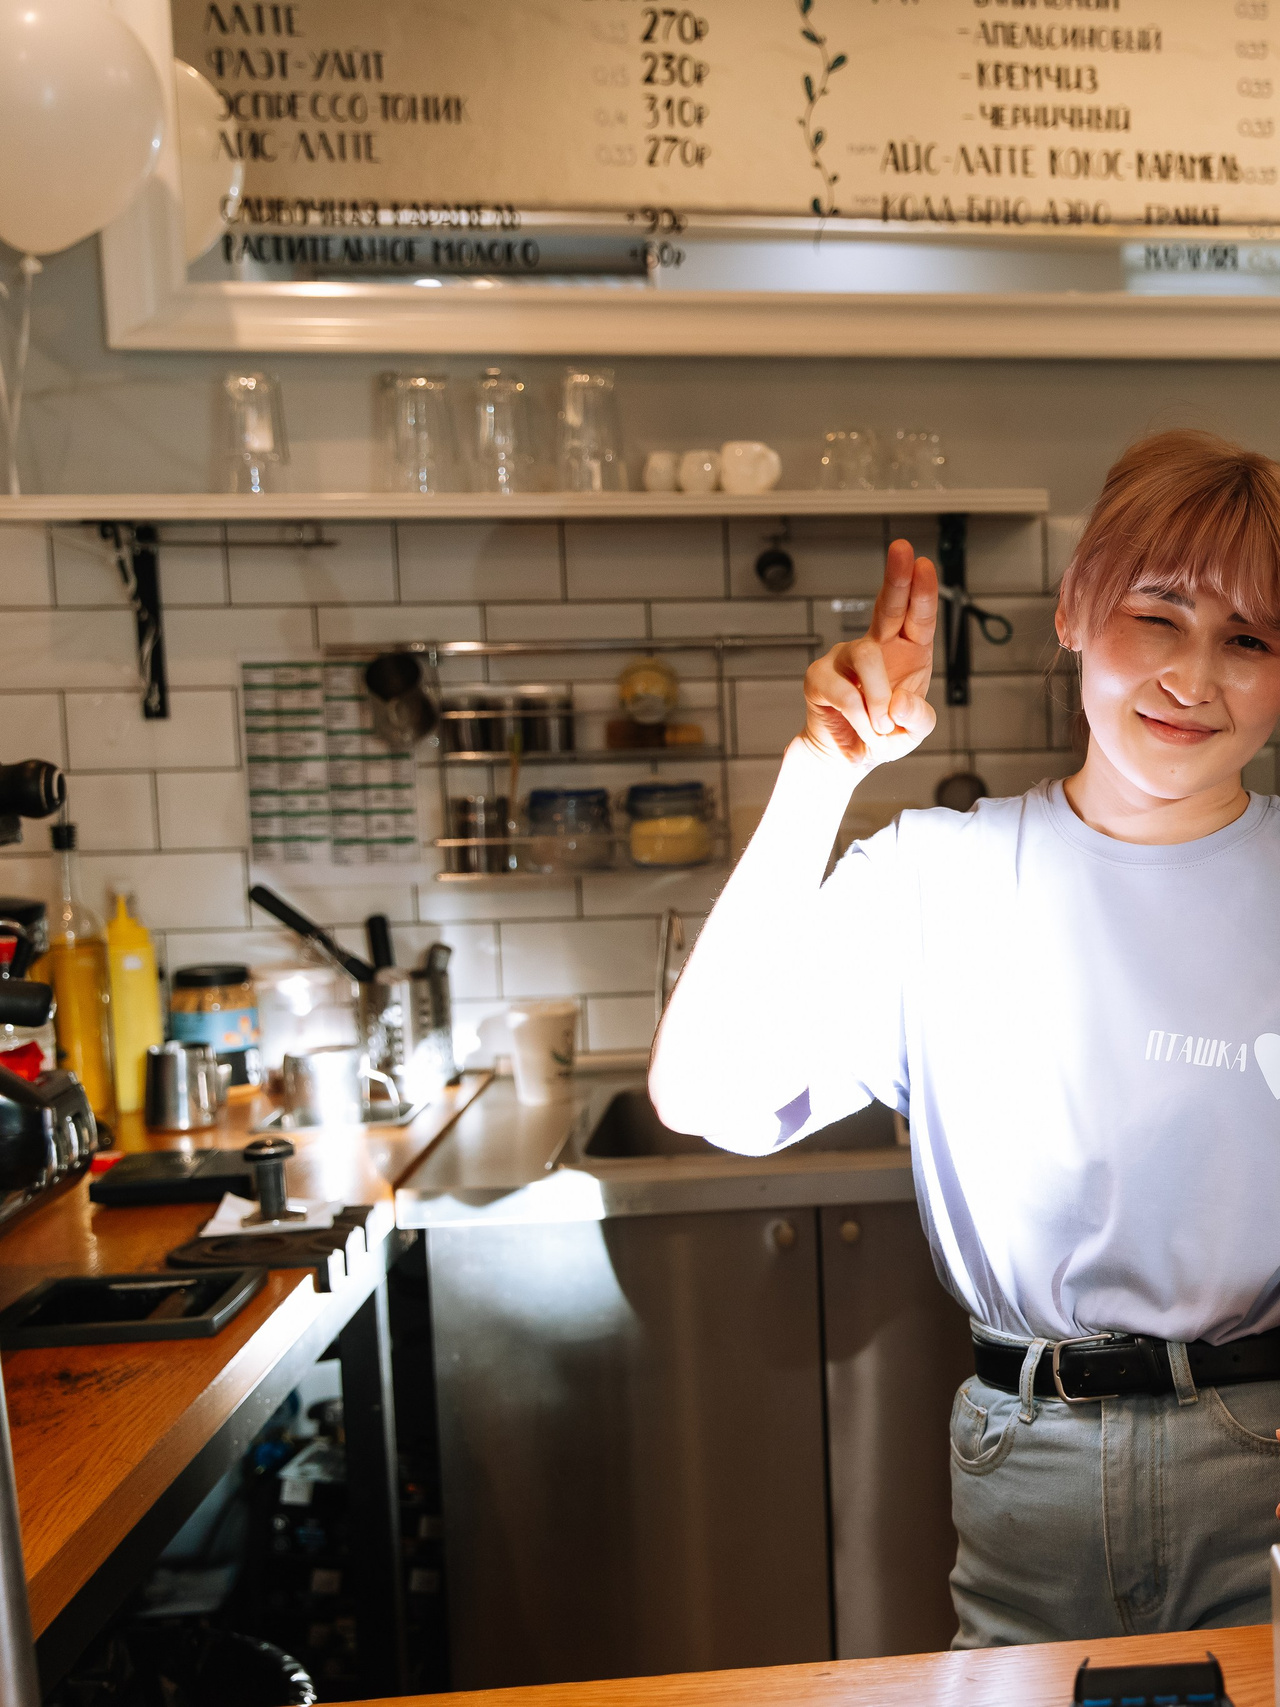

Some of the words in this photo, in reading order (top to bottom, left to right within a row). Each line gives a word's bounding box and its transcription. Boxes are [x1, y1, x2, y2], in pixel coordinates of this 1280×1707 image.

[203, 2, 302, 37] ЛАТТЕ
[974, 20, 1162, 53] АПЕЛЬСИНОВЫЙ
[205, 45, 385, 82] ФЛЭТ-УАЙТ
[976, 61, 1099, 94] КРЕМЧИЗ
[979, 102, 1132, 133] ЧЕРНИЧНЫЙ
[880, 137, 1037, 178] АЙС-ЛАТТЕ
[431, 237, 541, 268] МОЛОКО
[1145, 1030, 1248, 1073] ПТАШКА
